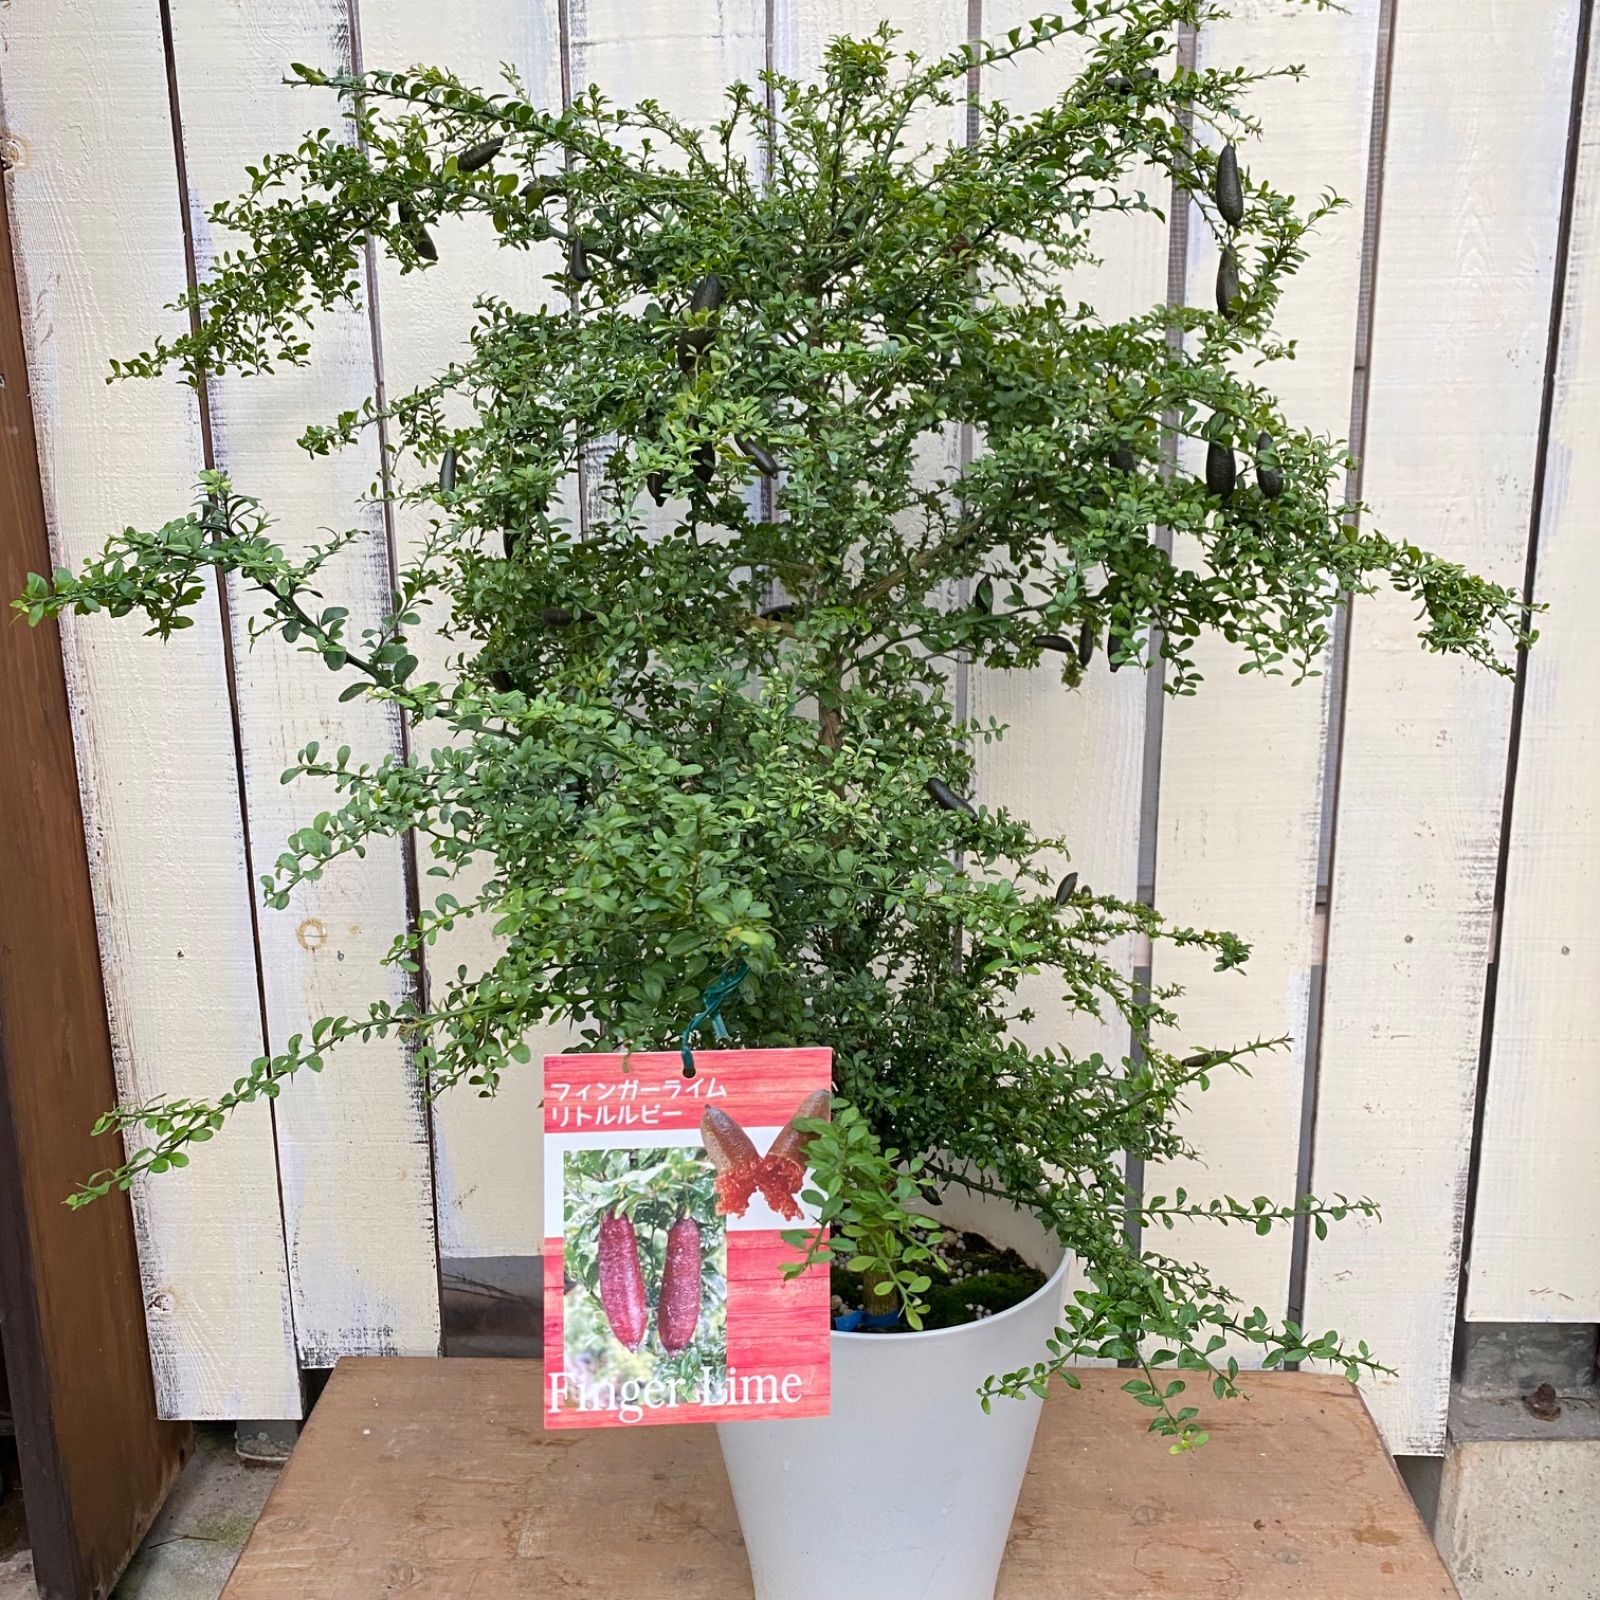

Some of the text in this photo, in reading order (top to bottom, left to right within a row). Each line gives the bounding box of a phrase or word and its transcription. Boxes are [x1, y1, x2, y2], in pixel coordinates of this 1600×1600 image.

[551, 1078, 728, 1102] フィンガーライム
[551, 1104, 683, 1127] リトルルビー
[547, 1365, 803, 1424] Finger Lime
